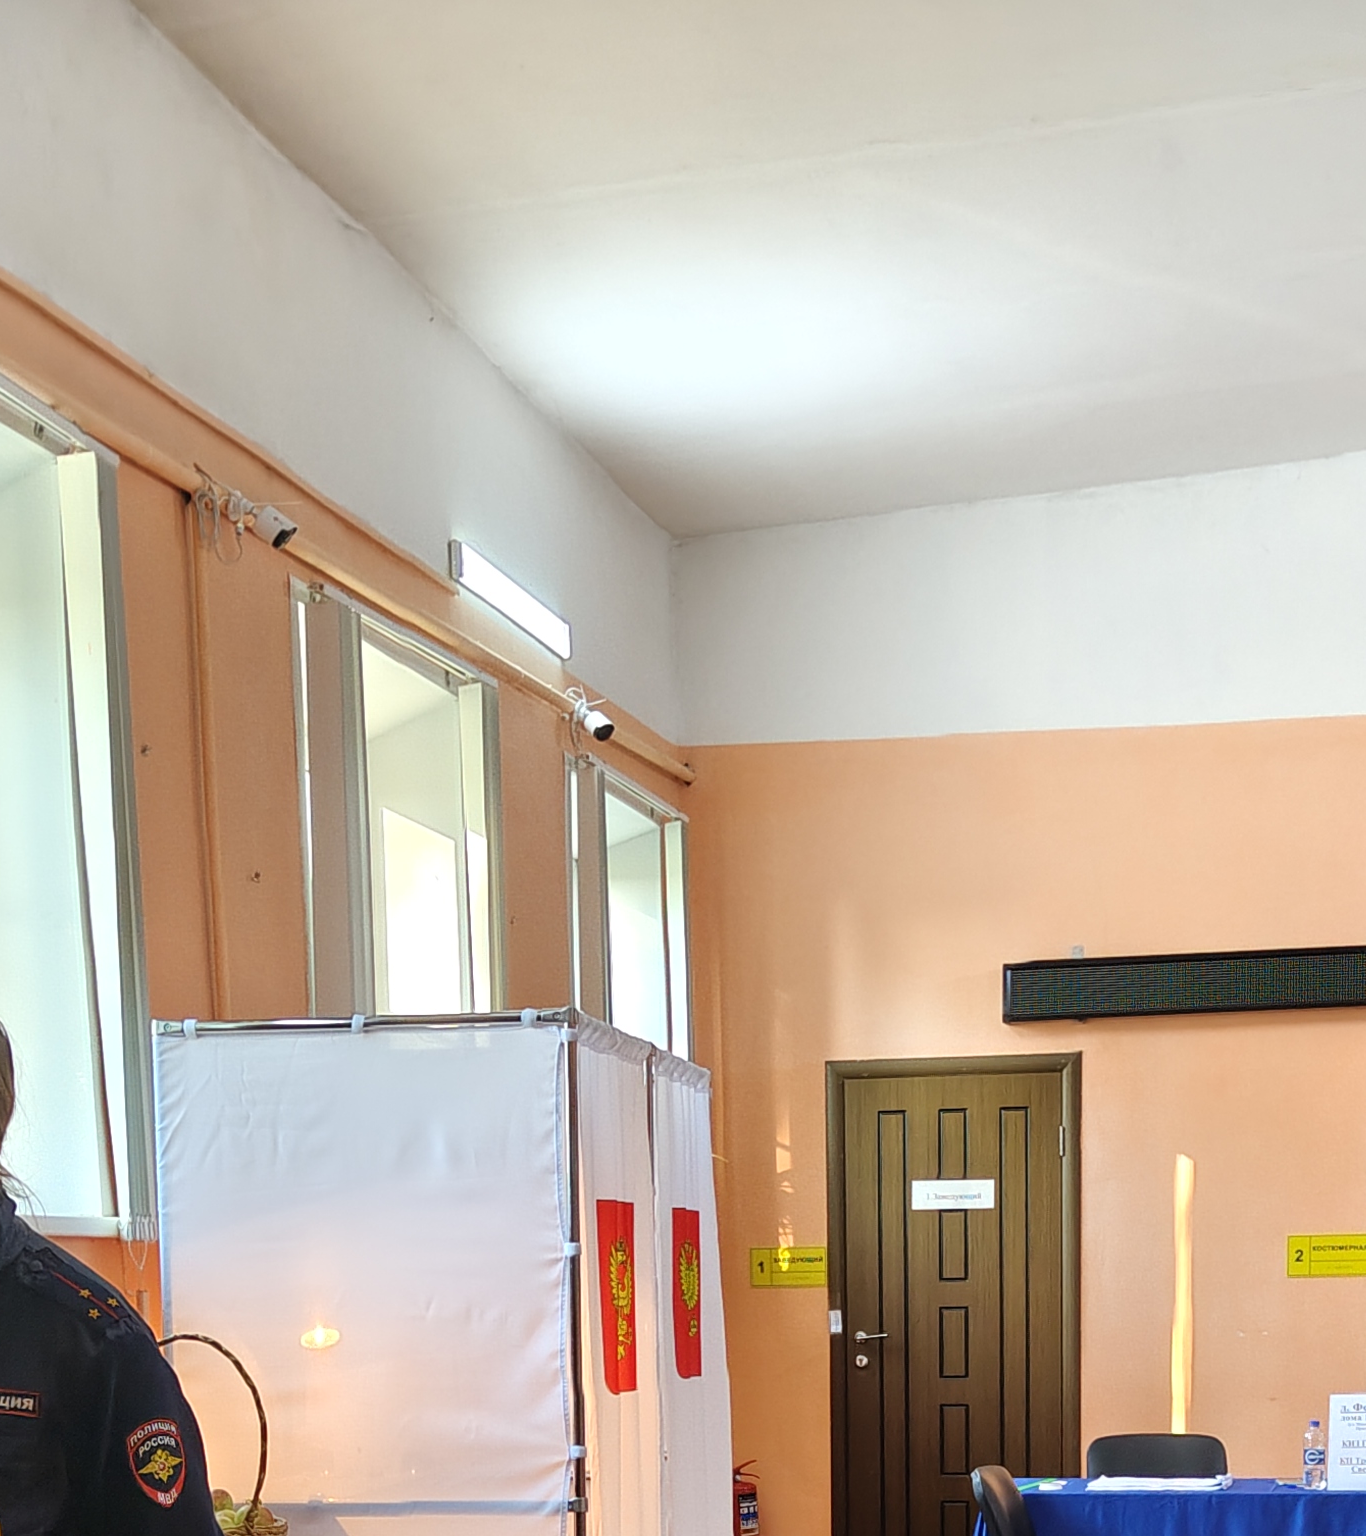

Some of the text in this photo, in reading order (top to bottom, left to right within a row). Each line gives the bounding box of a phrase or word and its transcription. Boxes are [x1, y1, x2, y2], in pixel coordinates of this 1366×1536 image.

[1294, 1249, 1304, 1263] 2
[757, 1260, 765, 1274] 1
[129, 1422, 177, 1447] ПОЛИЦИЯ
[138, 1435, 176, 1458] РОССИЯ
[157, 1488, 178, 1505] МВД
